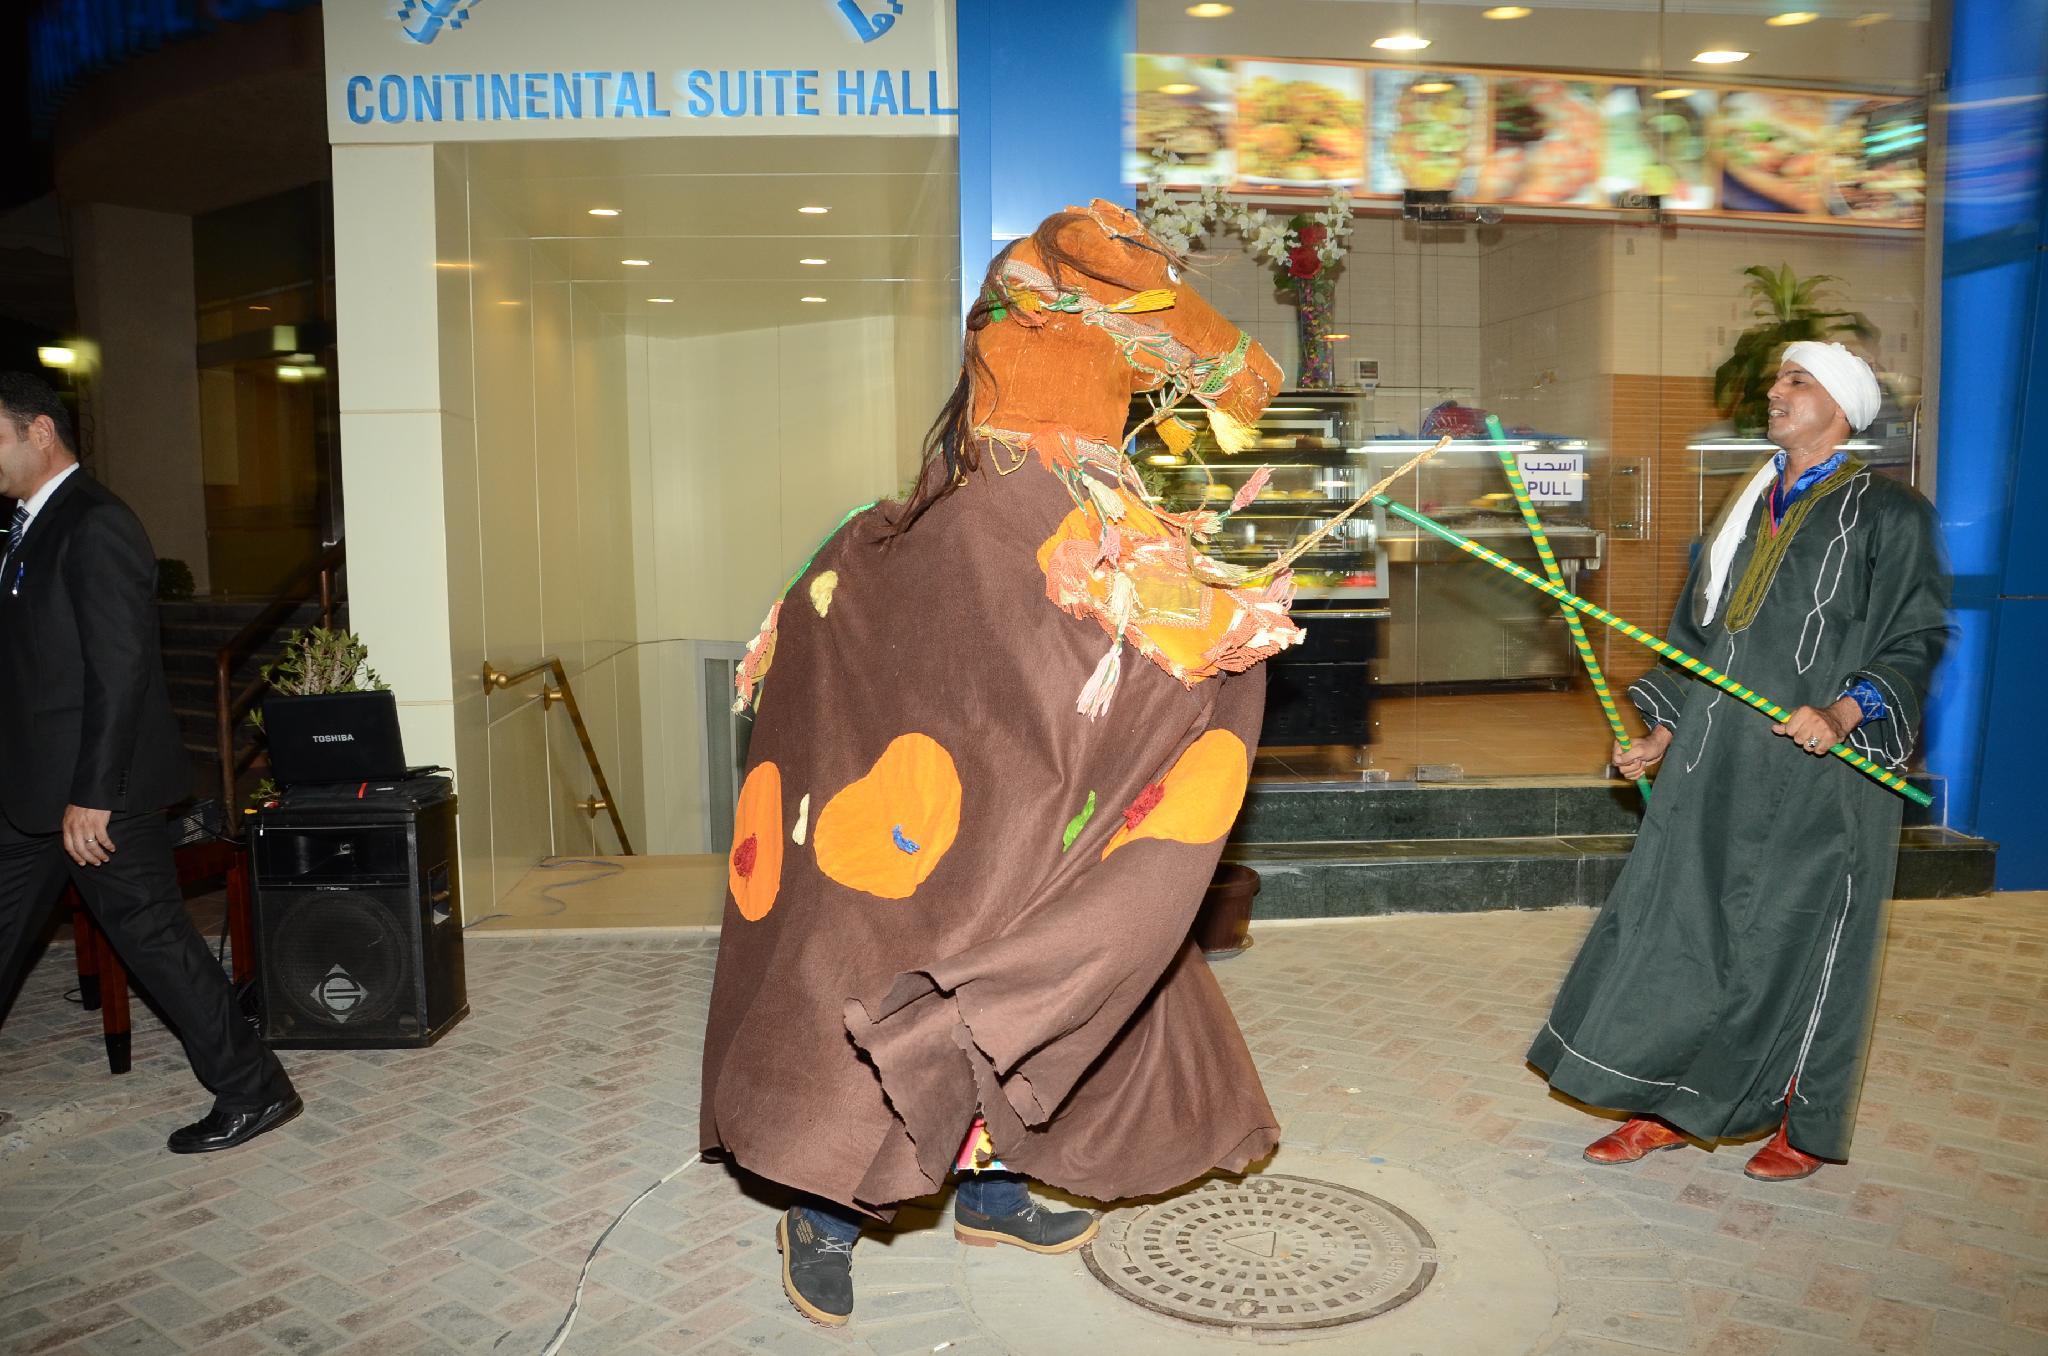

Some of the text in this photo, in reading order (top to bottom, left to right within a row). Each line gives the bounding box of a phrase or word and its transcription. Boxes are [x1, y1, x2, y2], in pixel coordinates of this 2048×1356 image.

[347, 69, 958, 124] CONTINENTAL SUITE HALL
[1524, 459, 1576, 474] اسحب
[1527, 481, 1572, 496] PULL
[312, 733, 355, 743] TOSHIBA
